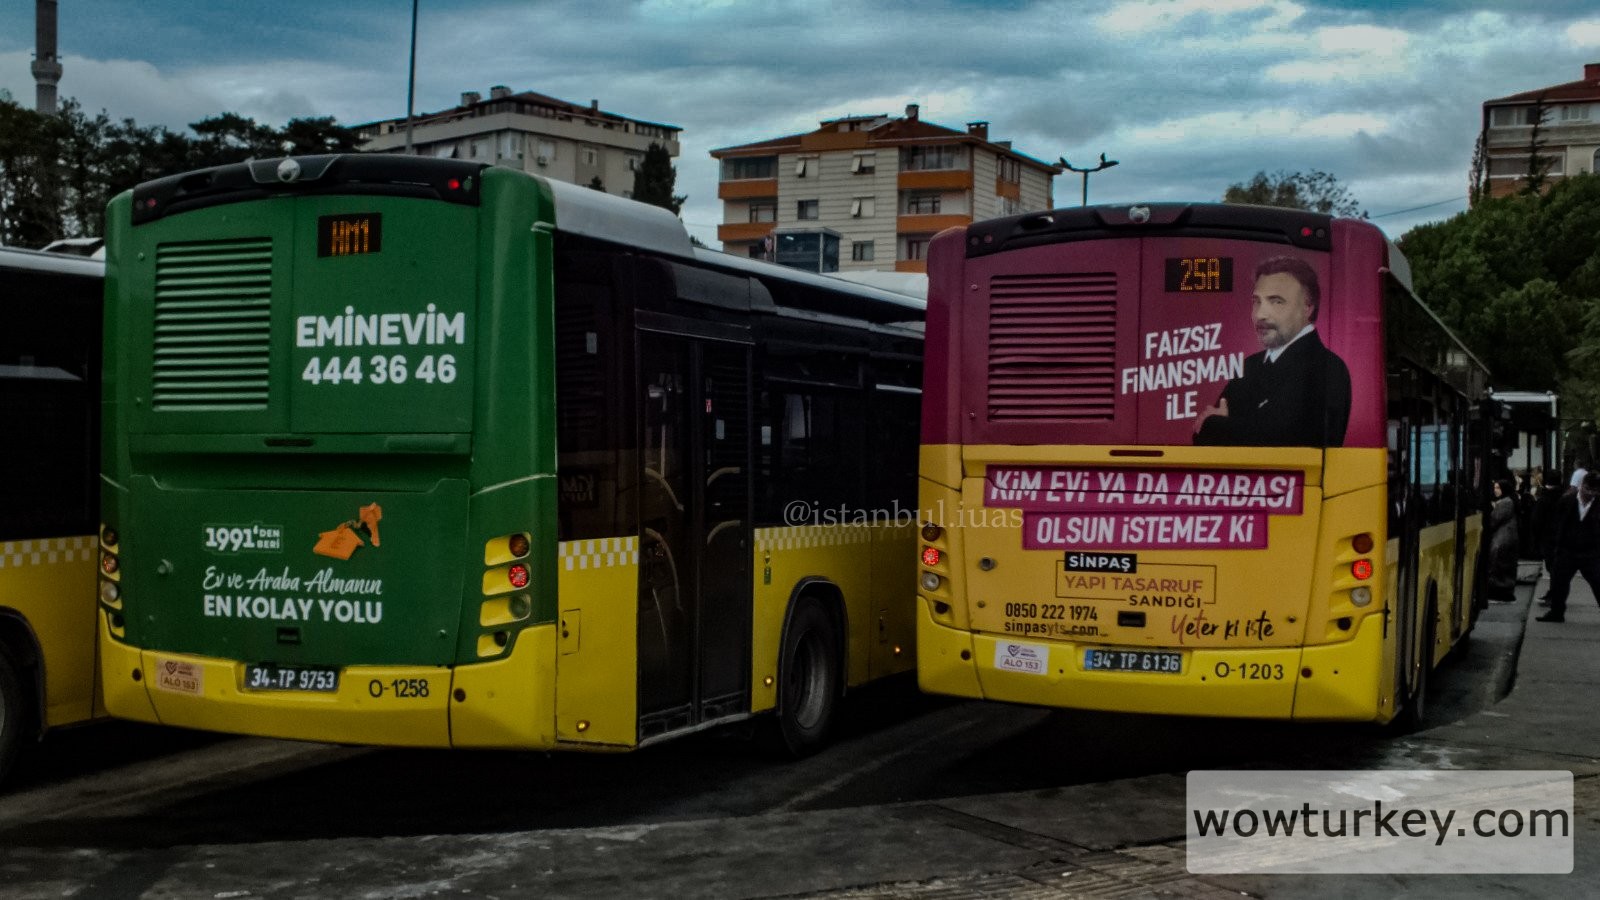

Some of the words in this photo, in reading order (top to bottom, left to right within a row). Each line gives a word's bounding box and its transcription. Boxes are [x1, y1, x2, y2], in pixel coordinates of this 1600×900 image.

[1180, 258, 1220, 291] 25A
[296, 303, 465, 347] EMİNEVİM
[302, 356, 362, 385] 444
[369, 355, 408, 384] 36
[415, 354, 457, 384] 46
[1096, 472, 1127, 504] YA
[1132, 473, 1169, 505] DA
[1174, 475, 1297, 508] ARABASI
[1035, 516, 1115, 544] OLSUN
[1069, 553, 1131, 572] SİNPAŞ
[202, 565, 225, 590] Ev
[227, 572, 244, 589] ve
[246, 566, 300, 591] Araba
[303, 567, 382, 595] Almanın
[1064, 575, 1105, 590] YAPI
[1111, 577, 1203, 593] TASARRUF
[203, 594, 232, 617] EN
[237, 596, 313, 621] KOLAY
[318, 599, 383, 624] YOLU
[1005, 602, 1037, 618] 0850
[1041, 604, 1065, 620] 222
[1069, 605, 1098, 621] 1974
[1129, 594, 1201, 608] SANDIĞI
[1094, 652, 1111, 668] 34
[1120, 652, 1137, 669] TP
[1142, 654, 1179, 671] 6136
[251, 667, 269, 687] 34
[278, 669, 296, 688] TP
[299, 670, 335, 689] 9753
